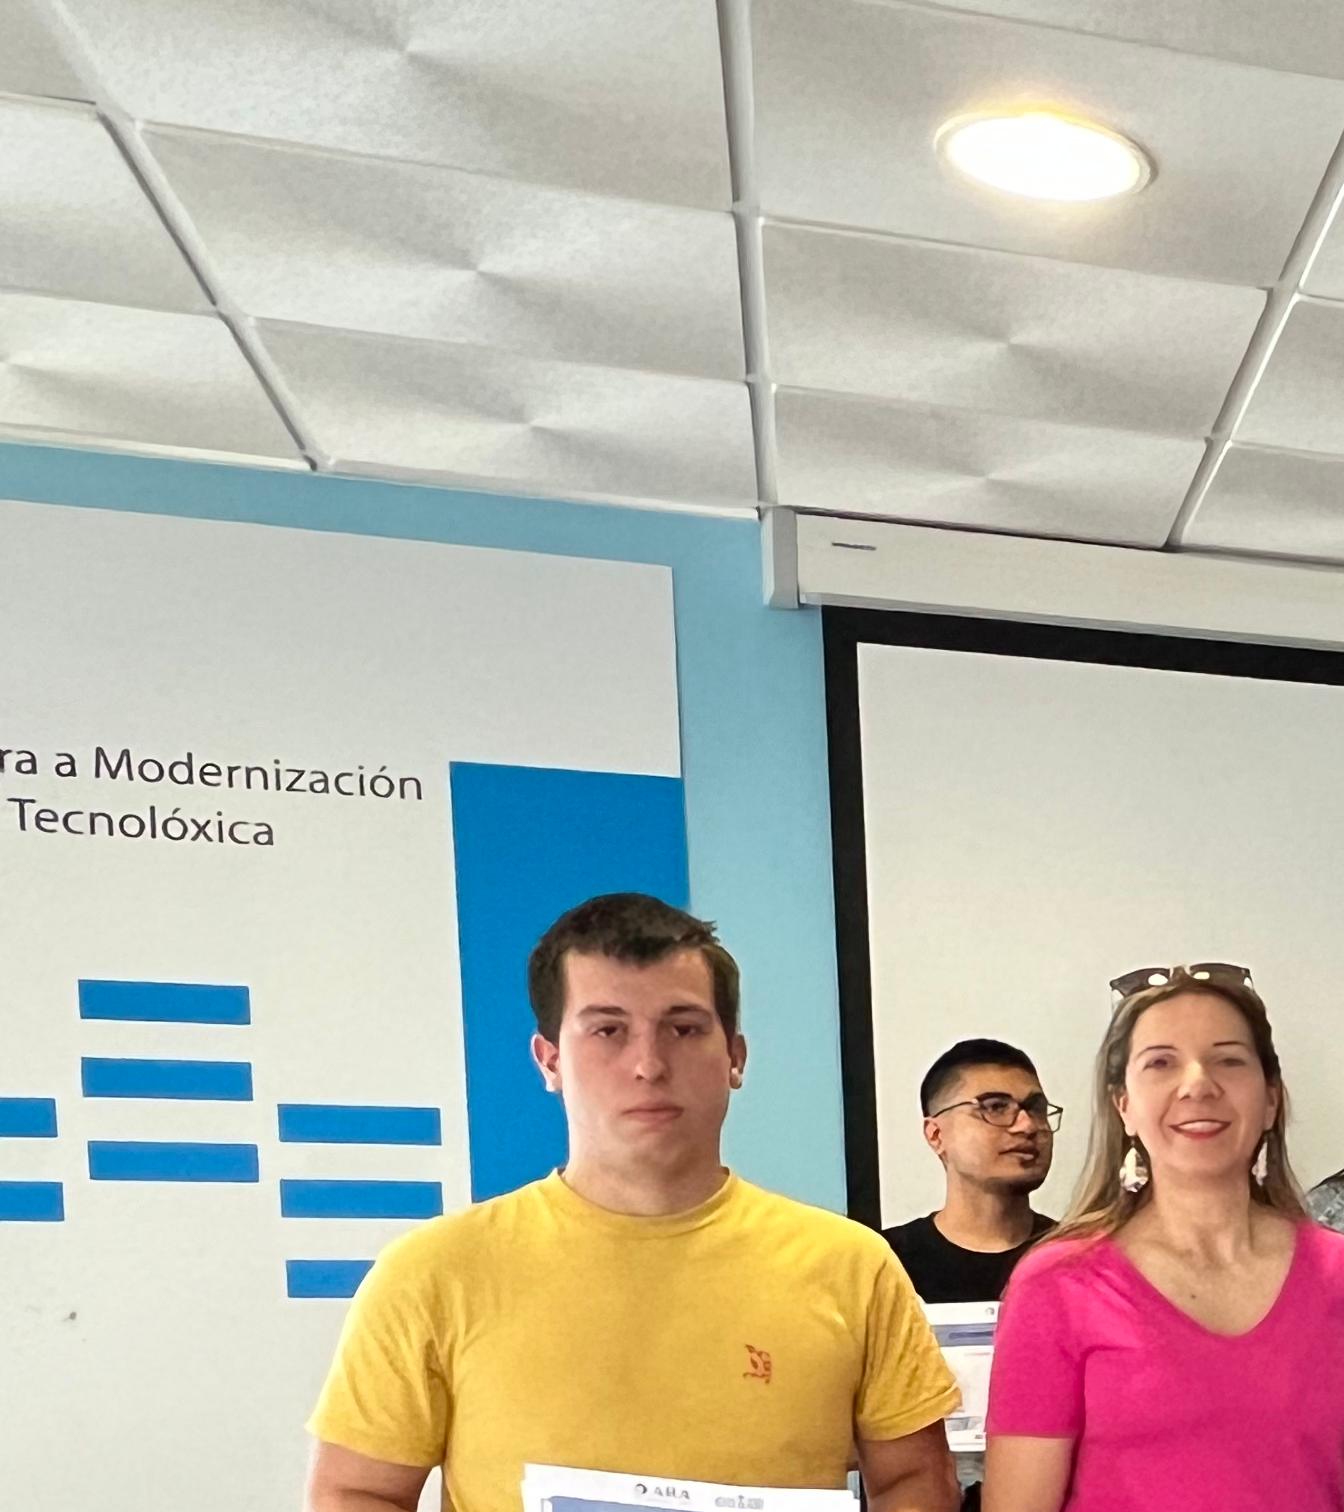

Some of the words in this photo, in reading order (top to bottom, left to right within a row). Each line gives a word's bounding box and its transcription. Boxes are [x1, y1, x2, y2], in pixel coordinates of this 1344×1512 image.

[54, 753, 77, 777] a
[94, 746, 422, 799] Modernización
[8, 797, 274, 846] Tecnolóxica
